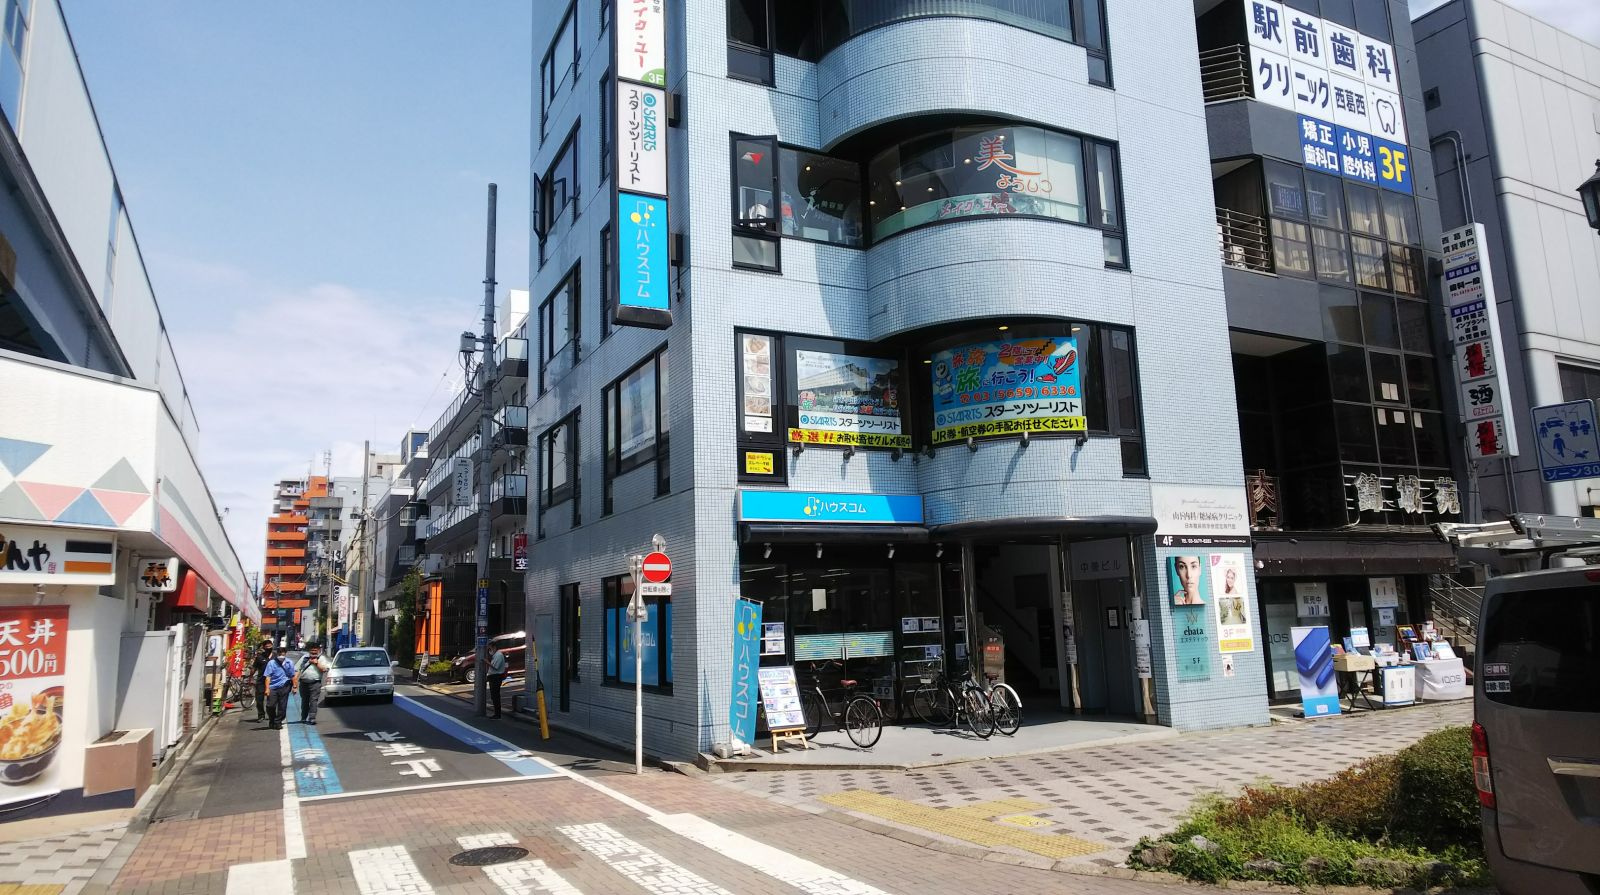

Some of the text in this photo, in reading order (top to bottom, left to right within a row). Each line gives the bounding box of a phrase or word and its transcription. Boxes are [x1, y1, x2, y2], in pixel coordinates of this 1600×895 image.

[1252, 1, 1392, 83] 駅前歯科
[648, 72, 664, 84] 3F
[1259, 57, 1367, 117] クリニック 西葛西
[629, 89, 641, 185] スターツツーリスト
[1302, 119, 1372, 158] 矯正 小児
[974, 136, 1042, 176] 美
[1379, 145, 1407, 183] 3F
[636, 229, 651, 298] ハウスコム
[1455, 317, 1488, 330] インプラント
[1041, 385, 1077, 396] 6336
[838, 417, 900, 430] スターツツーリスト
[947, 401, 1079, 424] STARTS スターツツーリスト
[820, 501, 867, 514] ハウスコム
[1162, 535, 1174, 546] 4F
[0, 536, 51, 572] んや
[0, 618, 57, 646] 天丼
[1183, 625, 1204, 636] ebata
[1223, 628, 1235, 638] 3F
[734, 642, 751, 738] ハウスコム
[1441, 673, 1462, 685] IQOS
